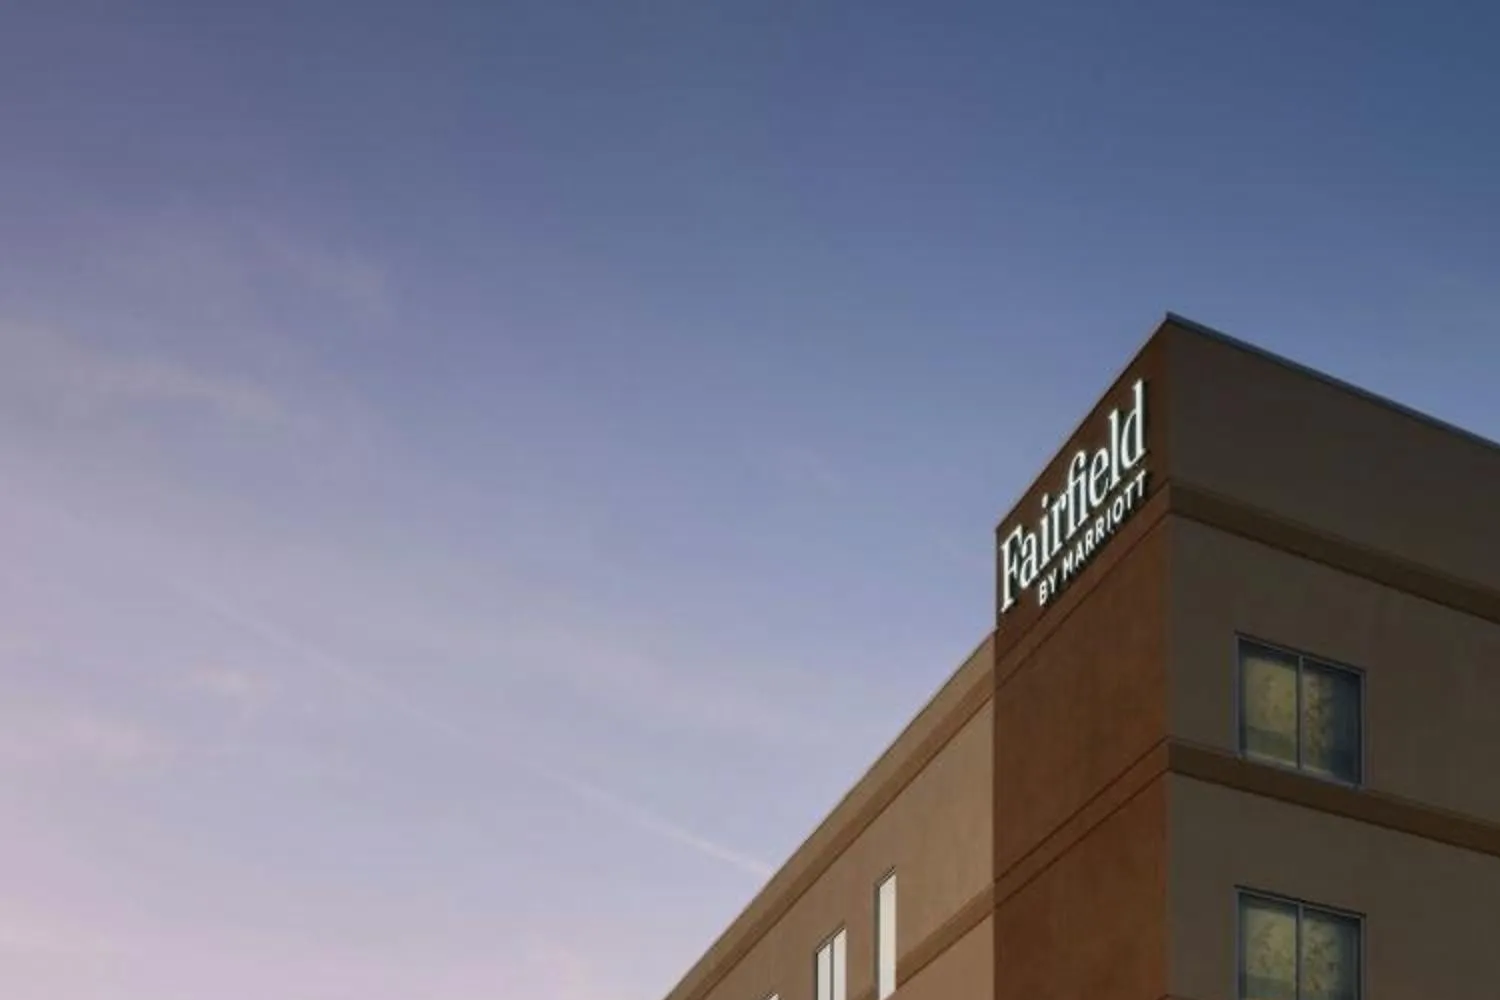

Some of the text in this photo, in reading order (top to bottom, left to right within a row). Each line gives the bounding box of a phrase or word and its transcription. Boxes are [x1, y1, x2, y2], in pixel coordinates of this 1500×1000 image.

[1001, 378, 1146, 613] Fairfield
[1038, 469, 1147, 606] BY MARRIOTT
